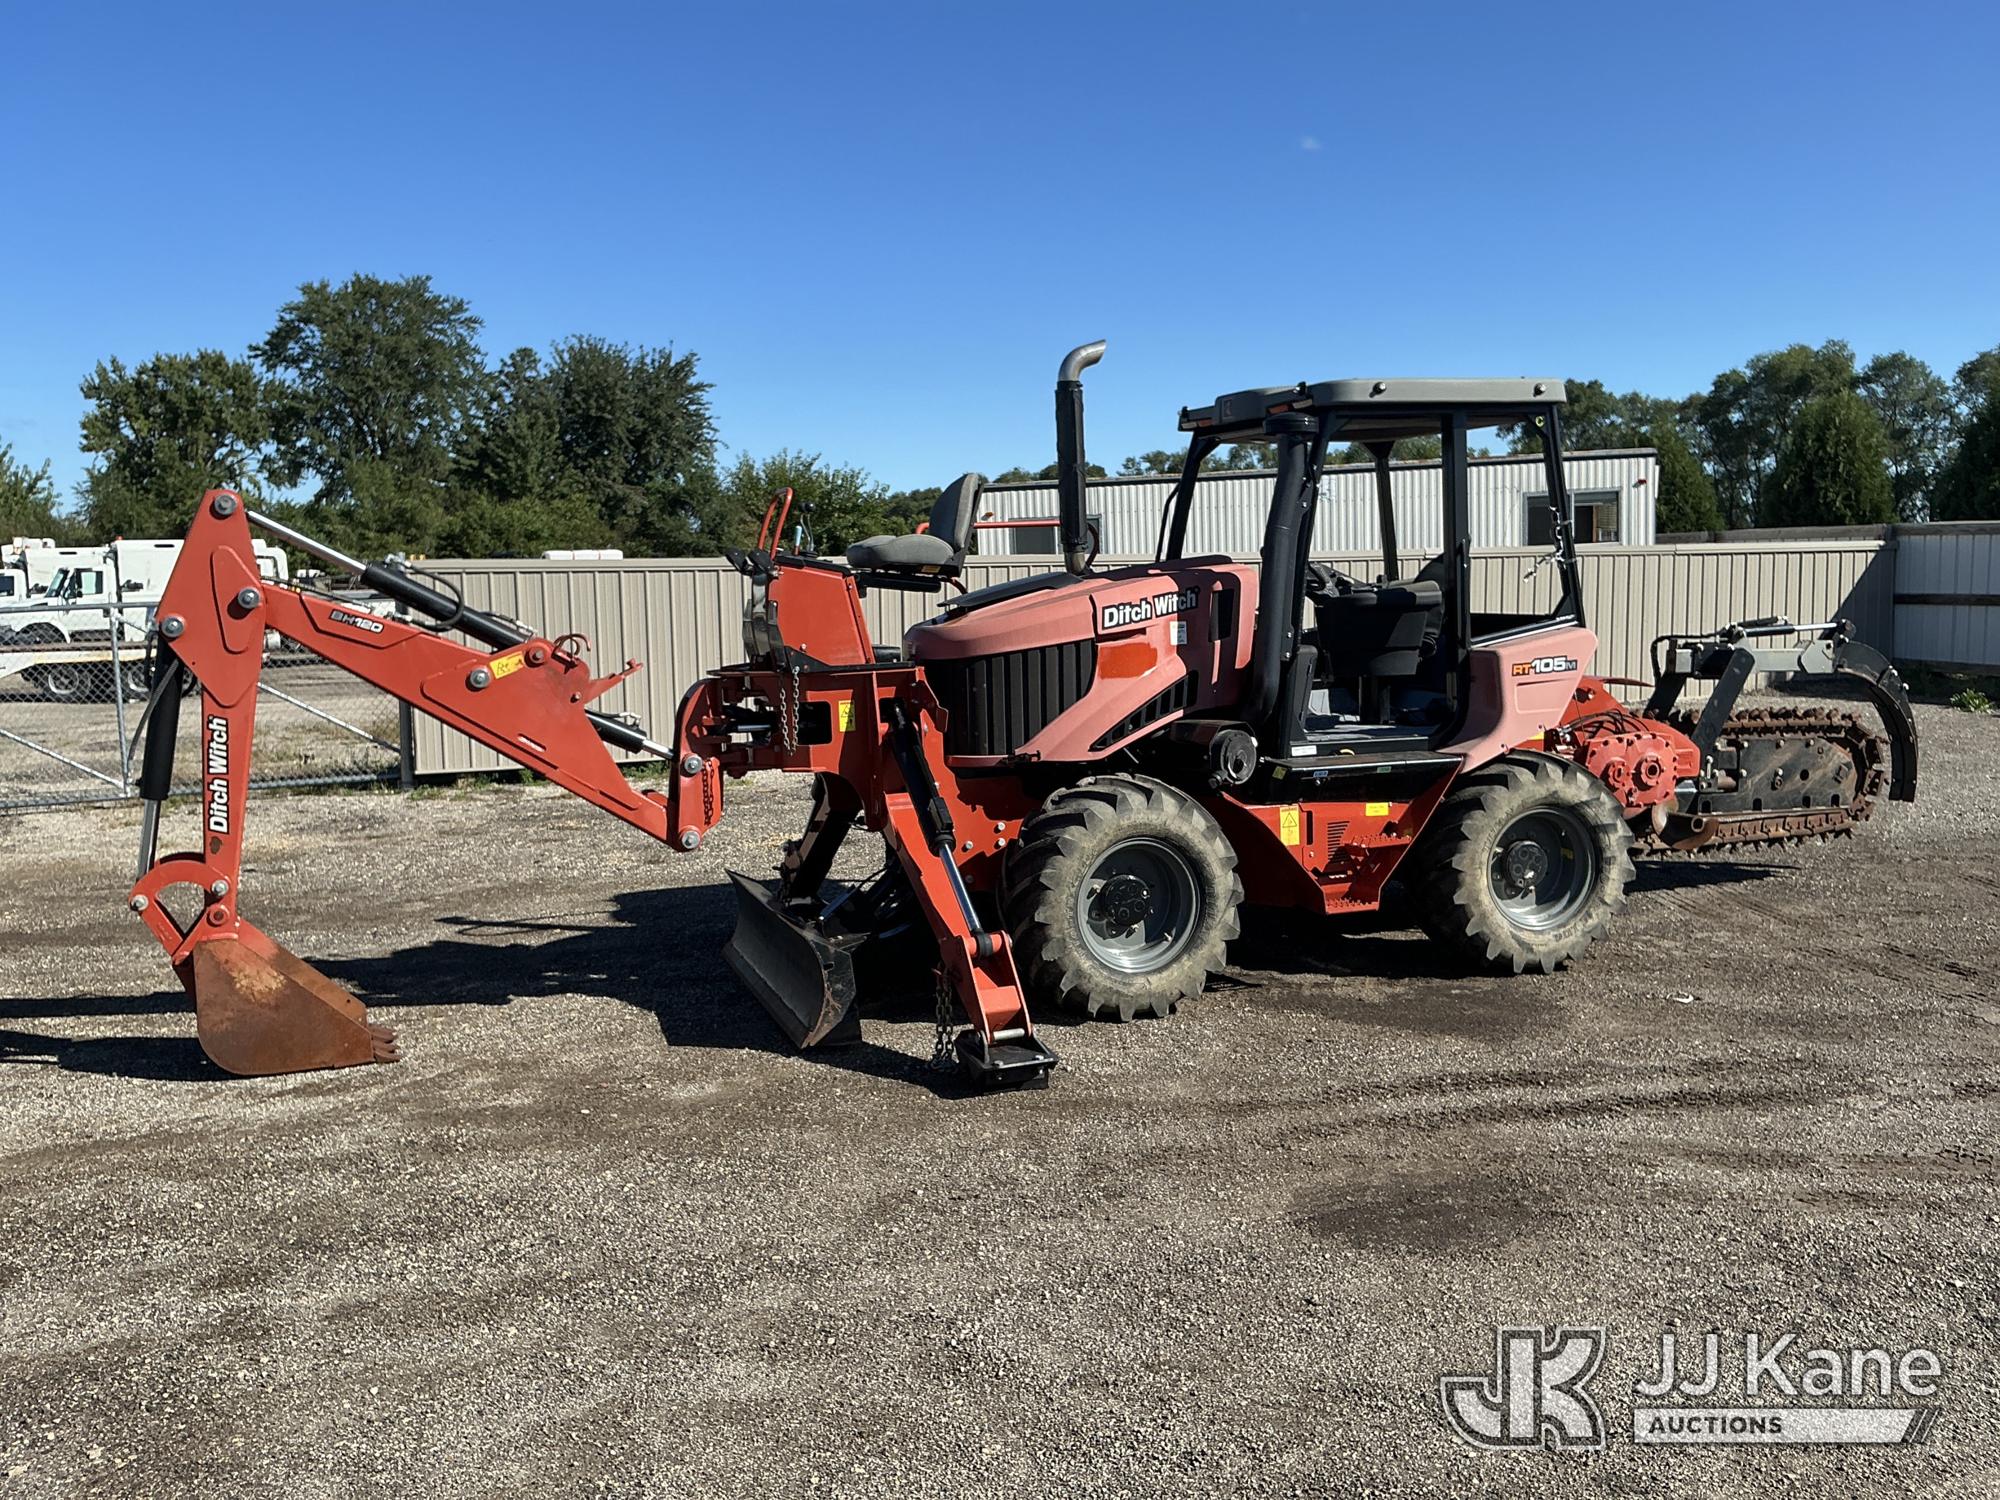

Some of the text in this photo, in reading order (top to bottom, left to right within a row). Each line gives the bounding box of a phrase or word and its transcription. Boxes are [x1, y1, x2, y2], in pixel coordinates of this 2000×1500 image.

[1102, 589, 1197, 629] Ditch Witch
[209, 716, 228, 833] Ditch Witch
